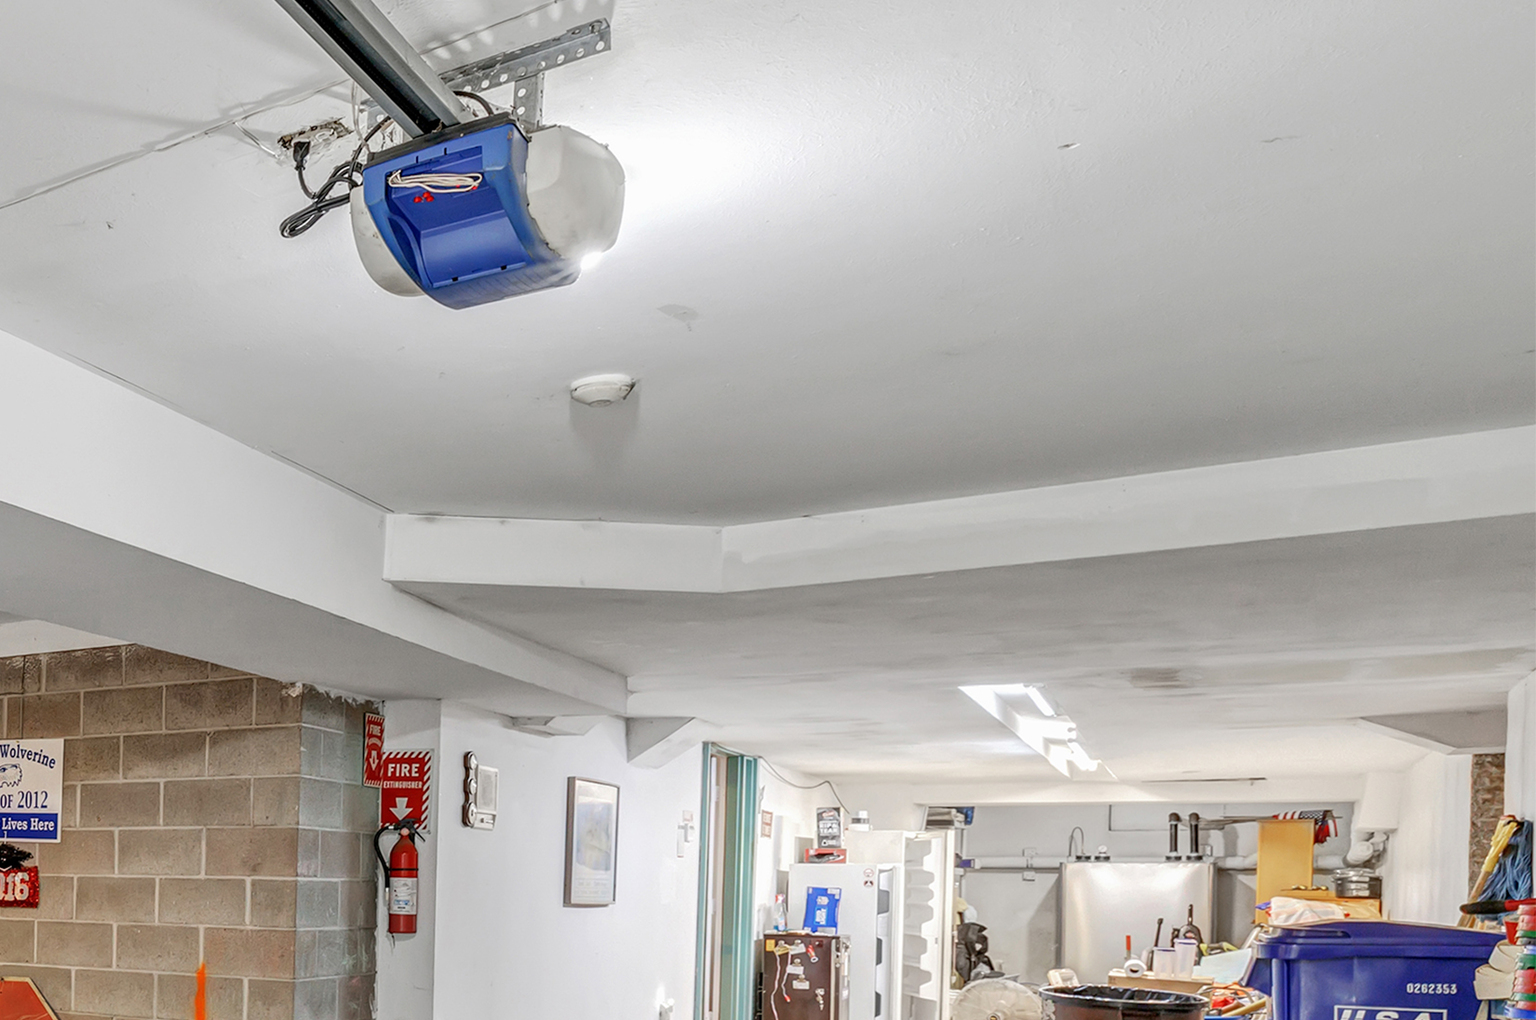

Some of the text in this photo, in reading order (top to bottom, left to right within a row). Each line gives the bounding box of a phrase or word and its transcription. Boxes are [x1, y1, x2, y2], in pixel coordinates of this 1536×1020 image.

[369, 724, 382, 736] FIRE
[0, 744, 56, 769] Wolverine
[387, 763, 420, 777] FIRE
[383, 781, 422, 789] EXTINGUISHER
[0, 794, 13, 808] OF
[17, 791, 48, 808] 2012
[2, 818, 28, 830] Lives
[30, 818, 55, 831] Here
[1406, 983, 1457, 994] 0262353
